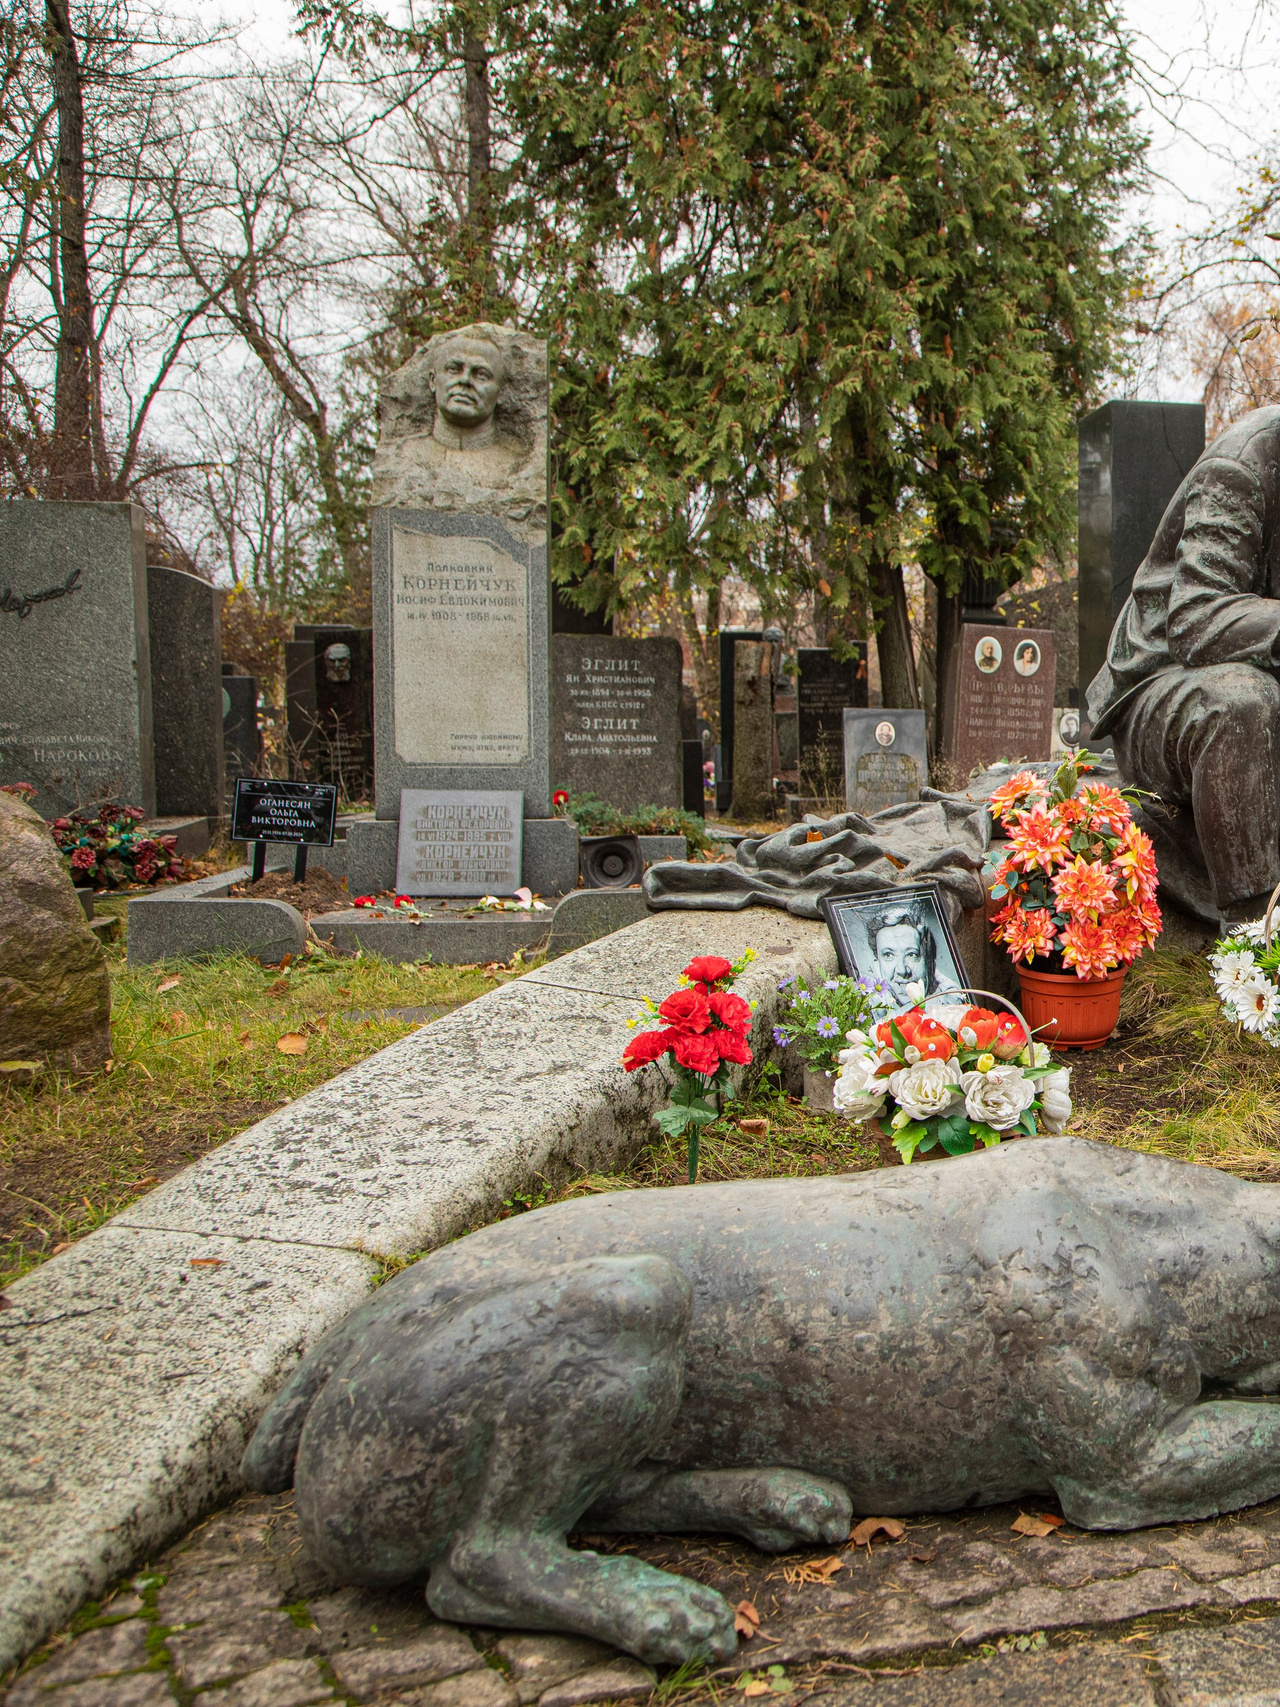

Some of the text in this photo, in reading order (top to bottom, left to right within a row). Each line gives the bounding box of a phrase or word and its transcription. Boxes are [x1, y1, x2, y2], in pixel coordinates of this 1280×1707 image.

[403, 575, 516, 592] КОРНЕЙЧУК
[581, 657, 641, 671] ЭГЛИТ
[581, 716, 641, 730] ЭГЛИТ
[259, 798, 311, 809] ОГАНЕСЯН
[270, 808, 299, 817] ОЛЬГА
[426, 804, 506, 819] КОРНЕЙЧУК
[251, 816, 316, 828] ВИКТОРОВНА
[425, 844, 506, 859] КОРНЕЙЧУК
